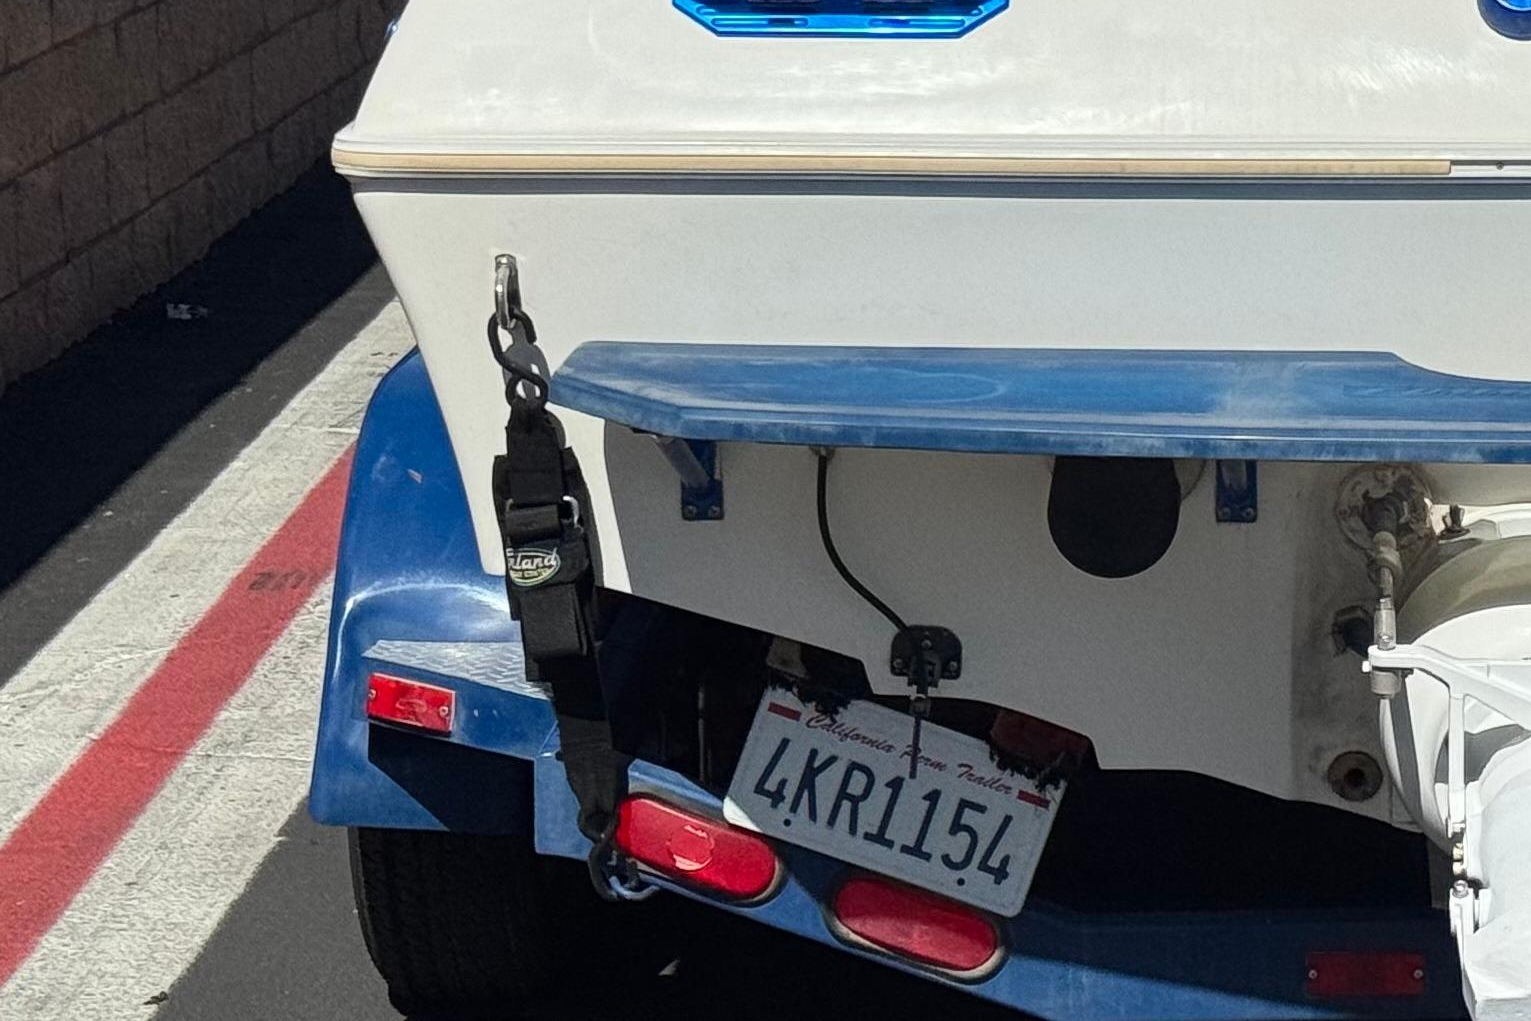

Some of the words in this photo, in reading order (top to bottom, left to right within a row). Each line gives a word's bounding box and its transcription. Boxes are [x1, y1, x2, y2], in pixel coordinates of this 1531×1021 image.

[753, 737, 1013, 886] 4KR1154
[804, 714, 896, 754] California
[899, 743, 948, 772] Perm
[956, 762, 1014, 795] Trailer
